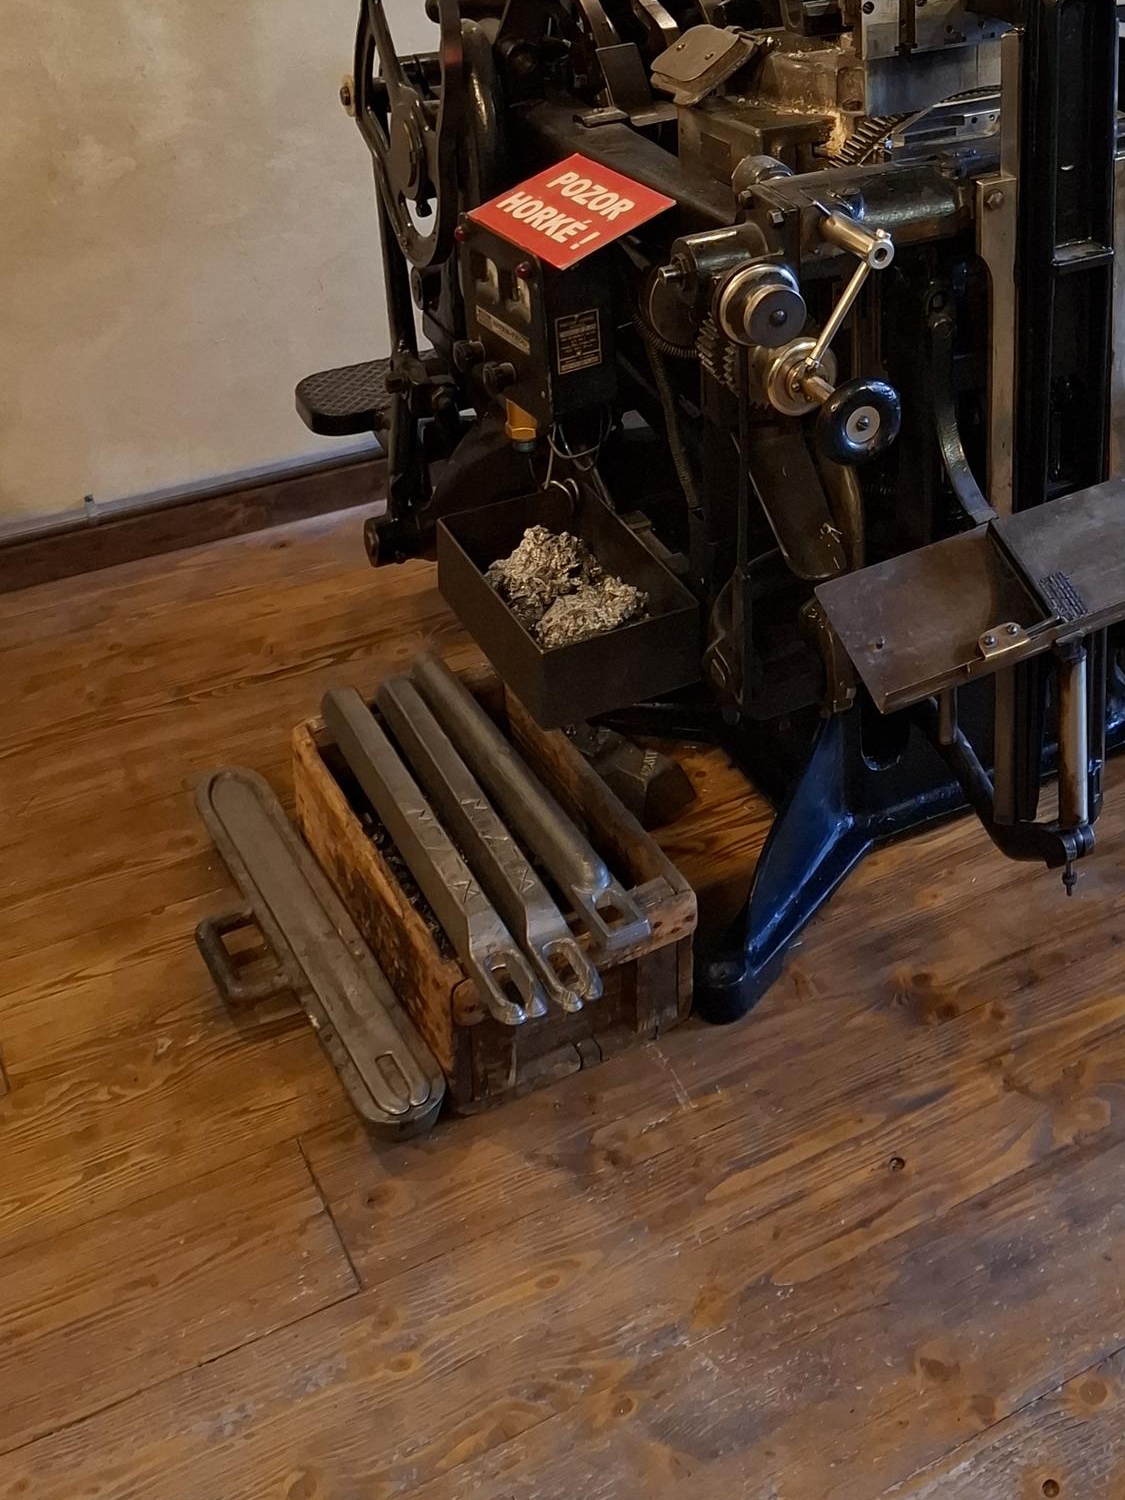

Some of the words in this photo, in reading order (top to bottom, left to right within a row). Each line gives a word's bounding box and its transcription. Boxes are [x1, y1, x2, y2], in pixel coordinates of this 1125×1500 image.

[496, 191, 593, 244] HORKÉ
[569, 231, 600, 250] !
[546, 171, 636, 222] POZOR
